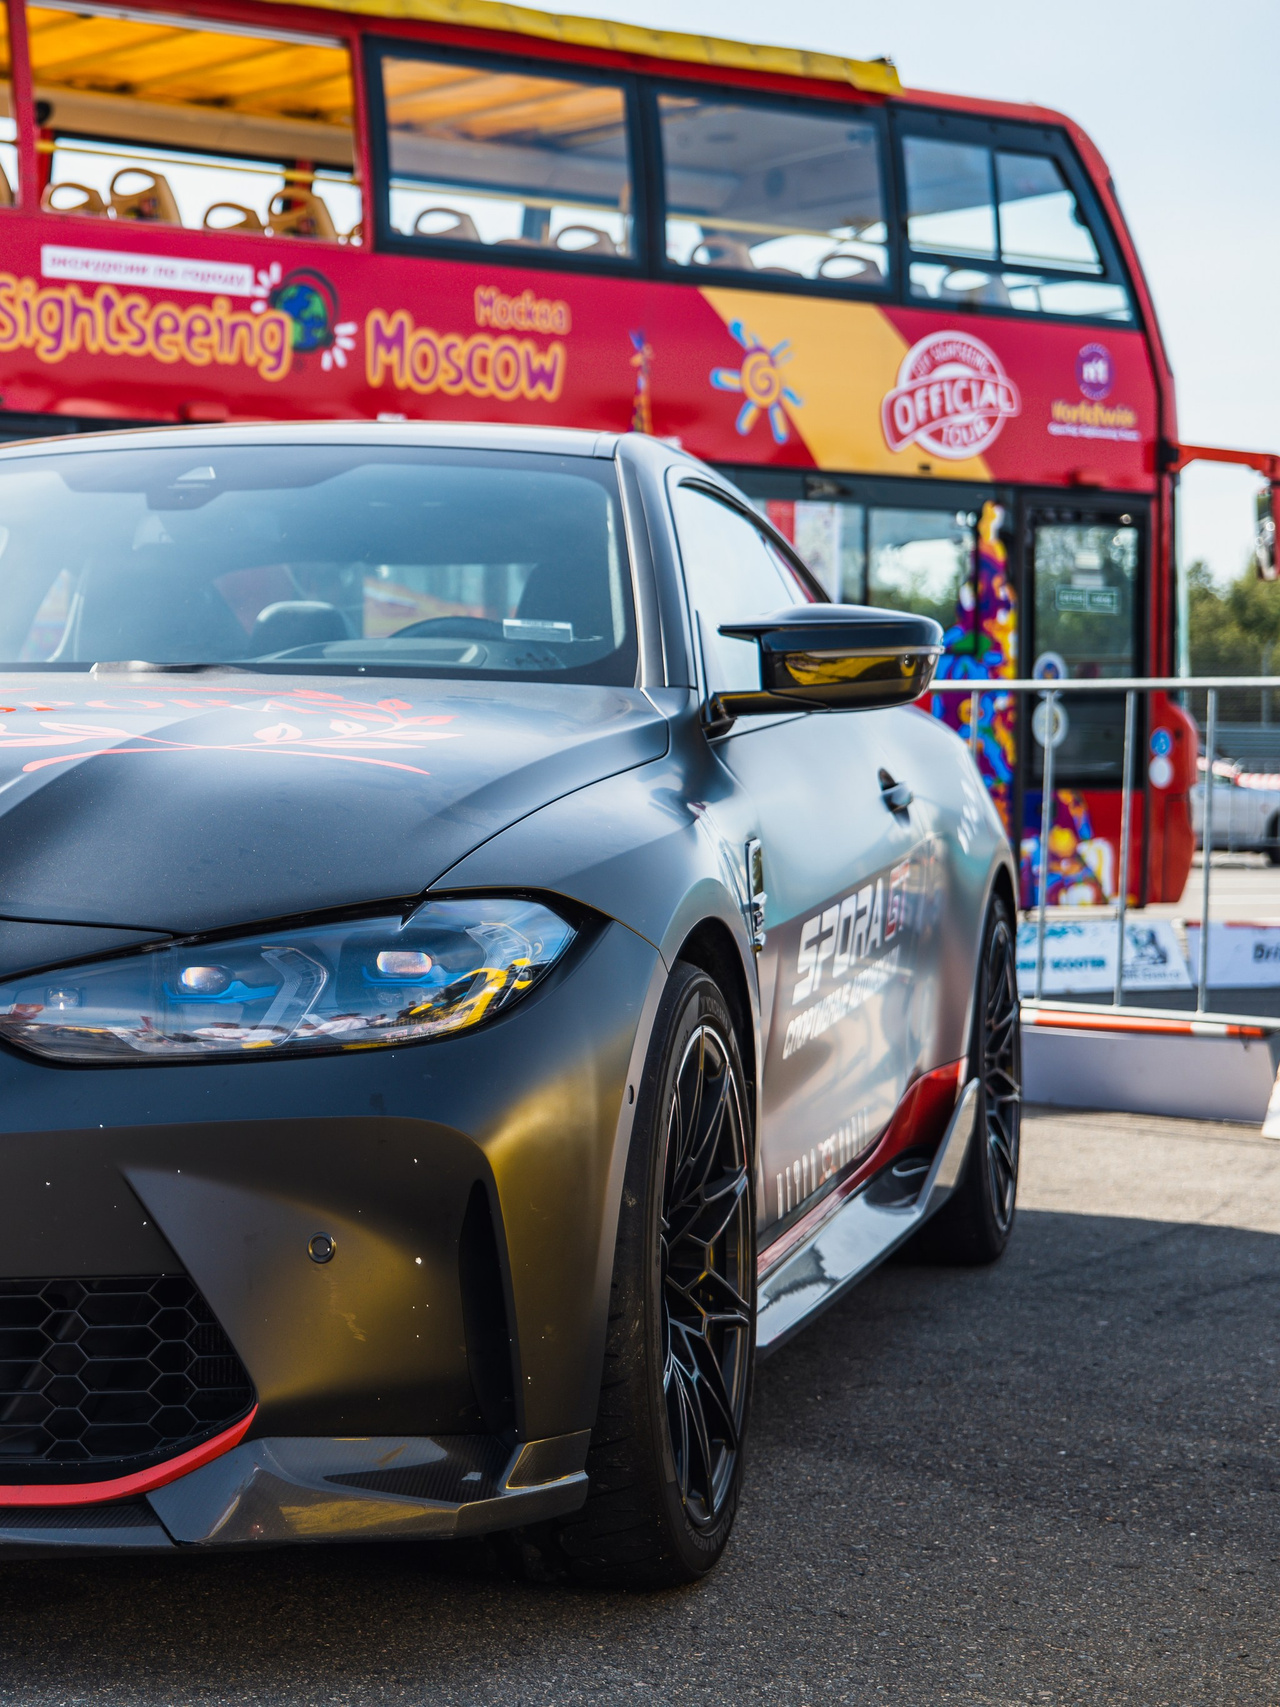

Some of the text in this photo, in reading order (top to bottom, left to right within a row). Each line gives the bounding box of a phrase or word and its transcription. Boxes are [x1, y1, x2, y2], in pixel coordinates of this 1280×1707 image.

[474, 284, 572, 334] Москва
[893, 378, 1012, 435] OFFICIAL
[941, 416, 990, 446] TOUR
[791, 878, 884, 1006] SPORA
